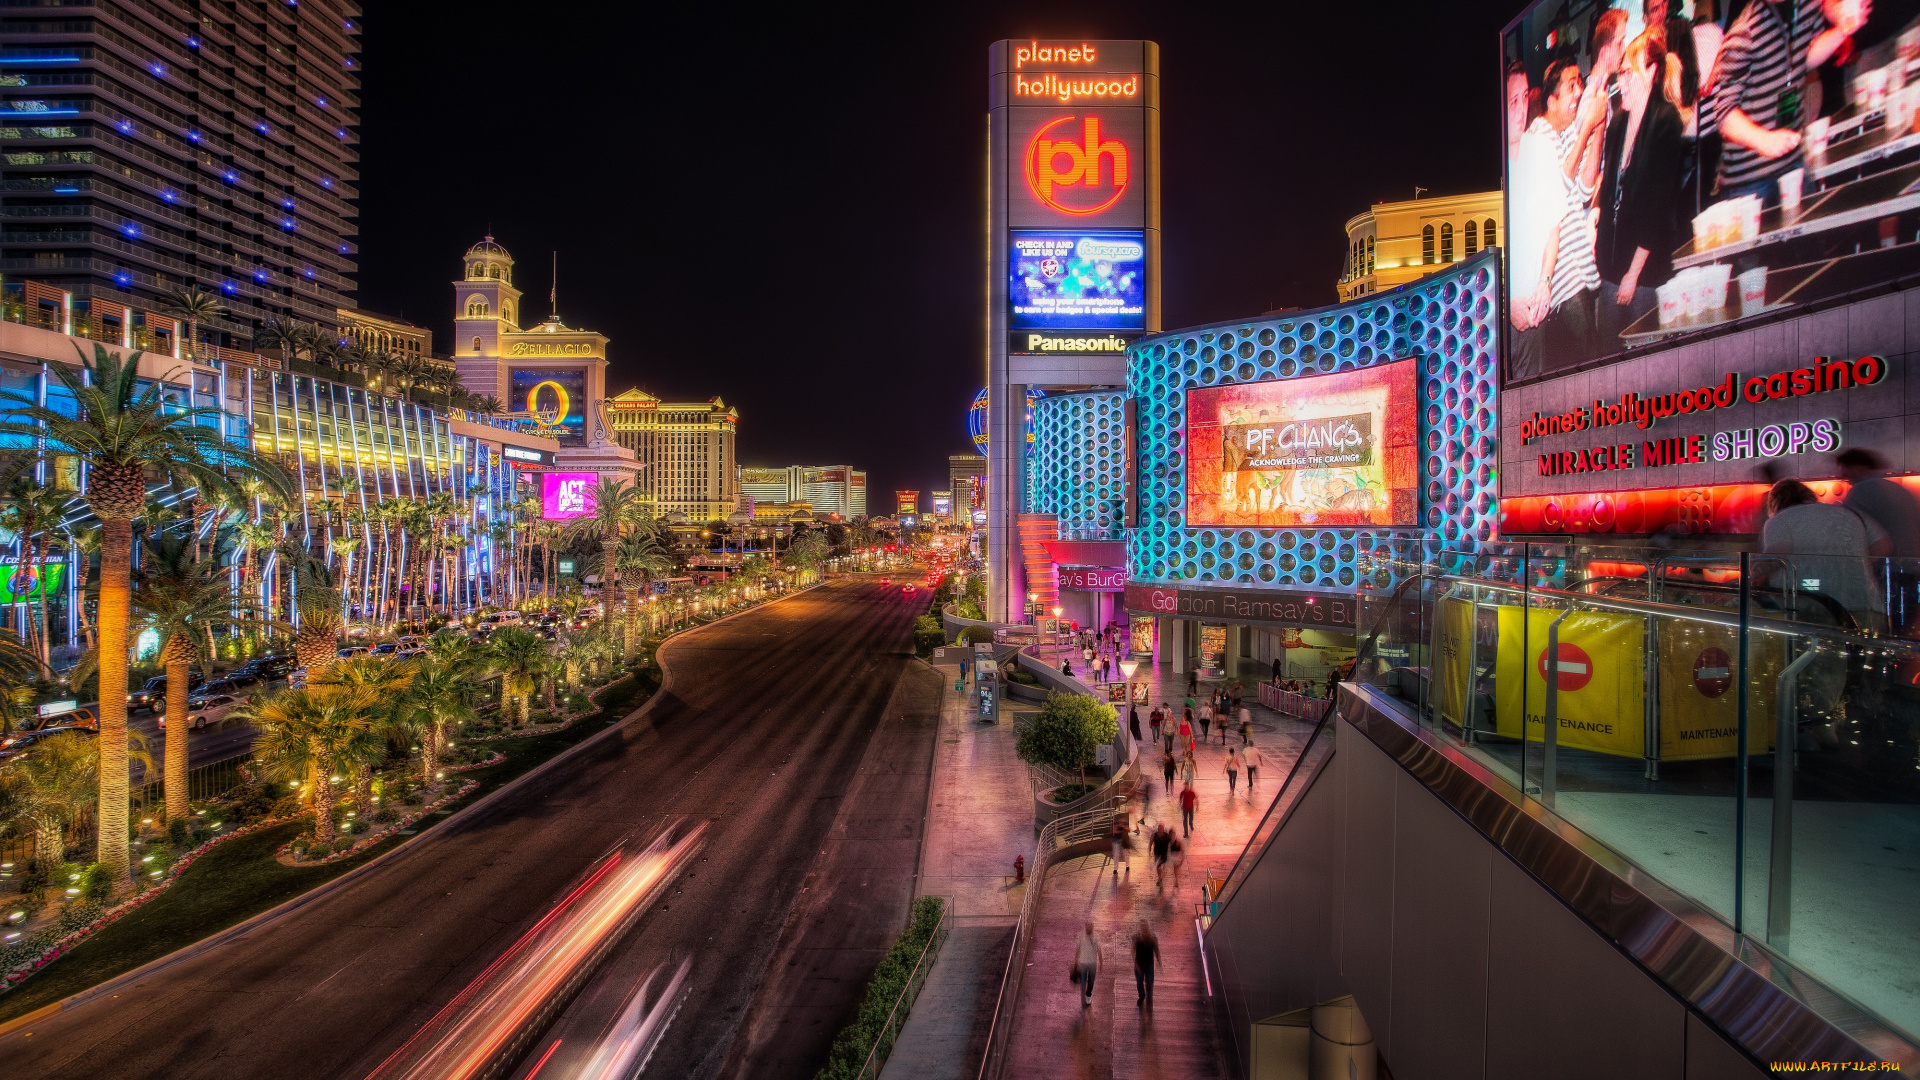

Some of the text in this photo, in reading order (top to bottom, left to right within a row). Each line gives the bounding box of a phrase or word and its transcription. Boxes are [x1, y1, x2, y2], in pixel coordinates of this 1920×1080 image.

[1016, 42, 1095, 68] planet
[1016, 75, 1137, 101] hollywood
[1037, 117, 1128, 201] ph
[1022, 248, 1068, 256] LIKE US ON
[1080, 242, 1140, 258] foursquare
[1056, 298, 1074, 307] your
[1076, 298, 1124, 306] smartphone
[1028, 334, 1126, 351] Panasonic
[1520, 355, 1882, 446] planet hollywood casino
[1537, 419, 1839, 476] MIRACLE MILE SHOPS
[1249, 457, 1306, 466] ACKNOWLEDGE
[558, 481, 585, 499] ACT
[1151, 590, 1215, 613] Gordon
[1224, 596, 1323, 621] Ramsay's
